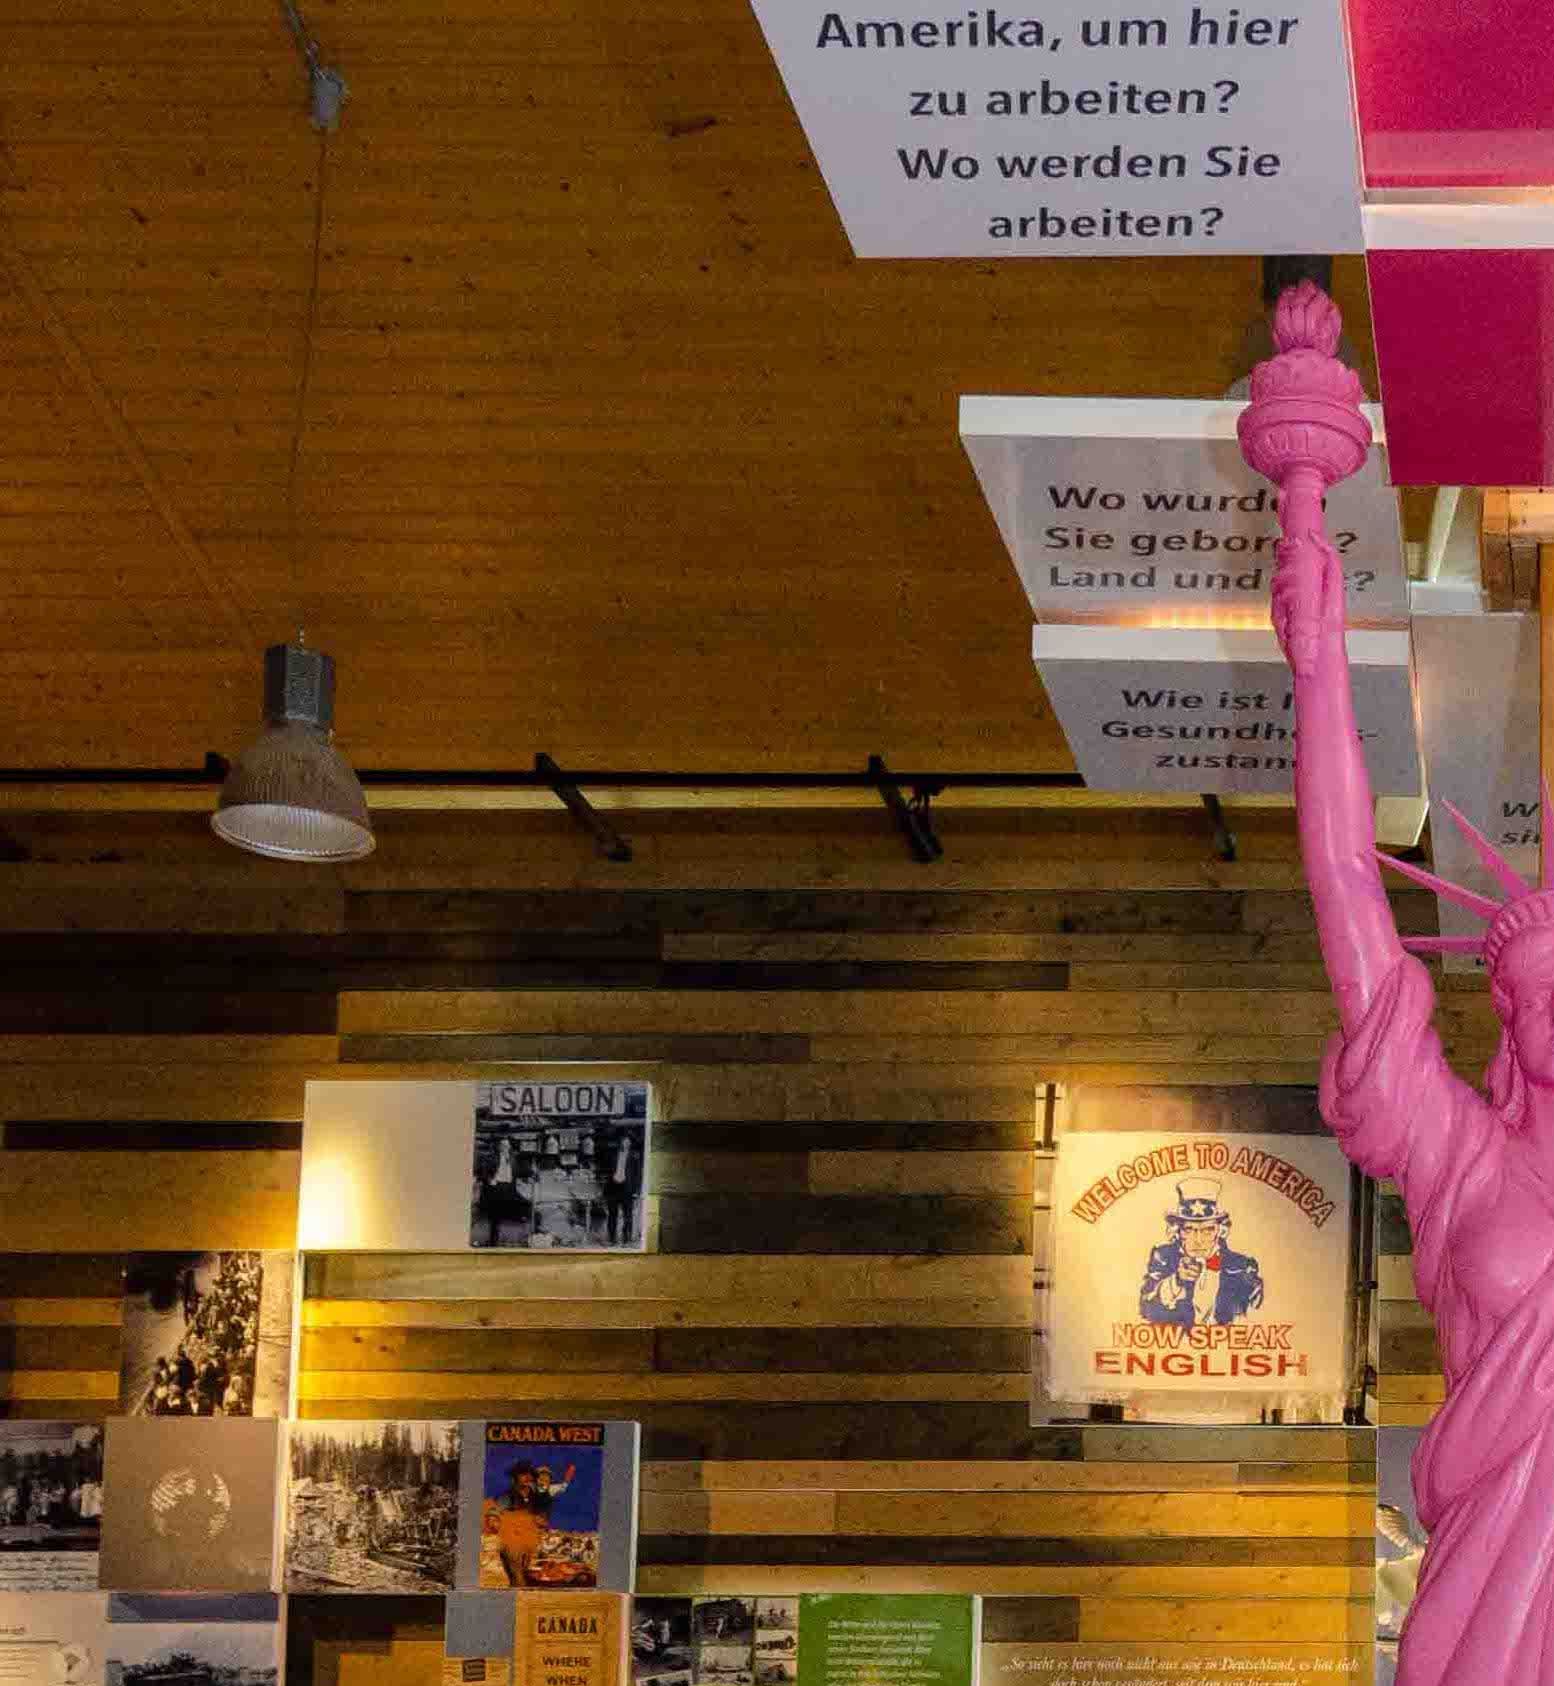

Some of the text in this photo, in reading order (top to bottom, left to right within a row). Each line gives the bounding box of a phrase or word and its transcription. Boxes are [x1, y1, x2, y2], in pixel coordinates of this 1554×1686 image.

[815, 9, 1299, 53] Amerika, um hier
[908, 79, 1239, 117] zu arbeiten?
[897, 145, 1282, 180] Wo werden Sie
[987, 206, 1225, 240] arbeiten?
[1047, 485, 1327, 512] Wo wurd
[1044, 527, 1359, 556] Sie gebor?
[1049, 566, 1262, 590] Land und
[1121, 689, 1204, 710] Wie
[1218, 689, 1270, 710] ist
[1101, 718, 1380, 742] Gesundh-
[1154, 752, 1298, 771] zustan
[501, 1086, 615, 1113] SALOON
[1071, 1143, 1338, 1229] WELCOME TO AMERICA
[1112, 1322, 1293, 1351] NOW SPEAK
[1093, 1352, 1309, 1378] ENGLISH
[487, 1425, 601, 1442] CANADA WEST
[537, 1615, 598, 1634] CANADA
[542, 1656, 592, 1668] WHERE
[546, 1675, 588, 1686] WHEN
